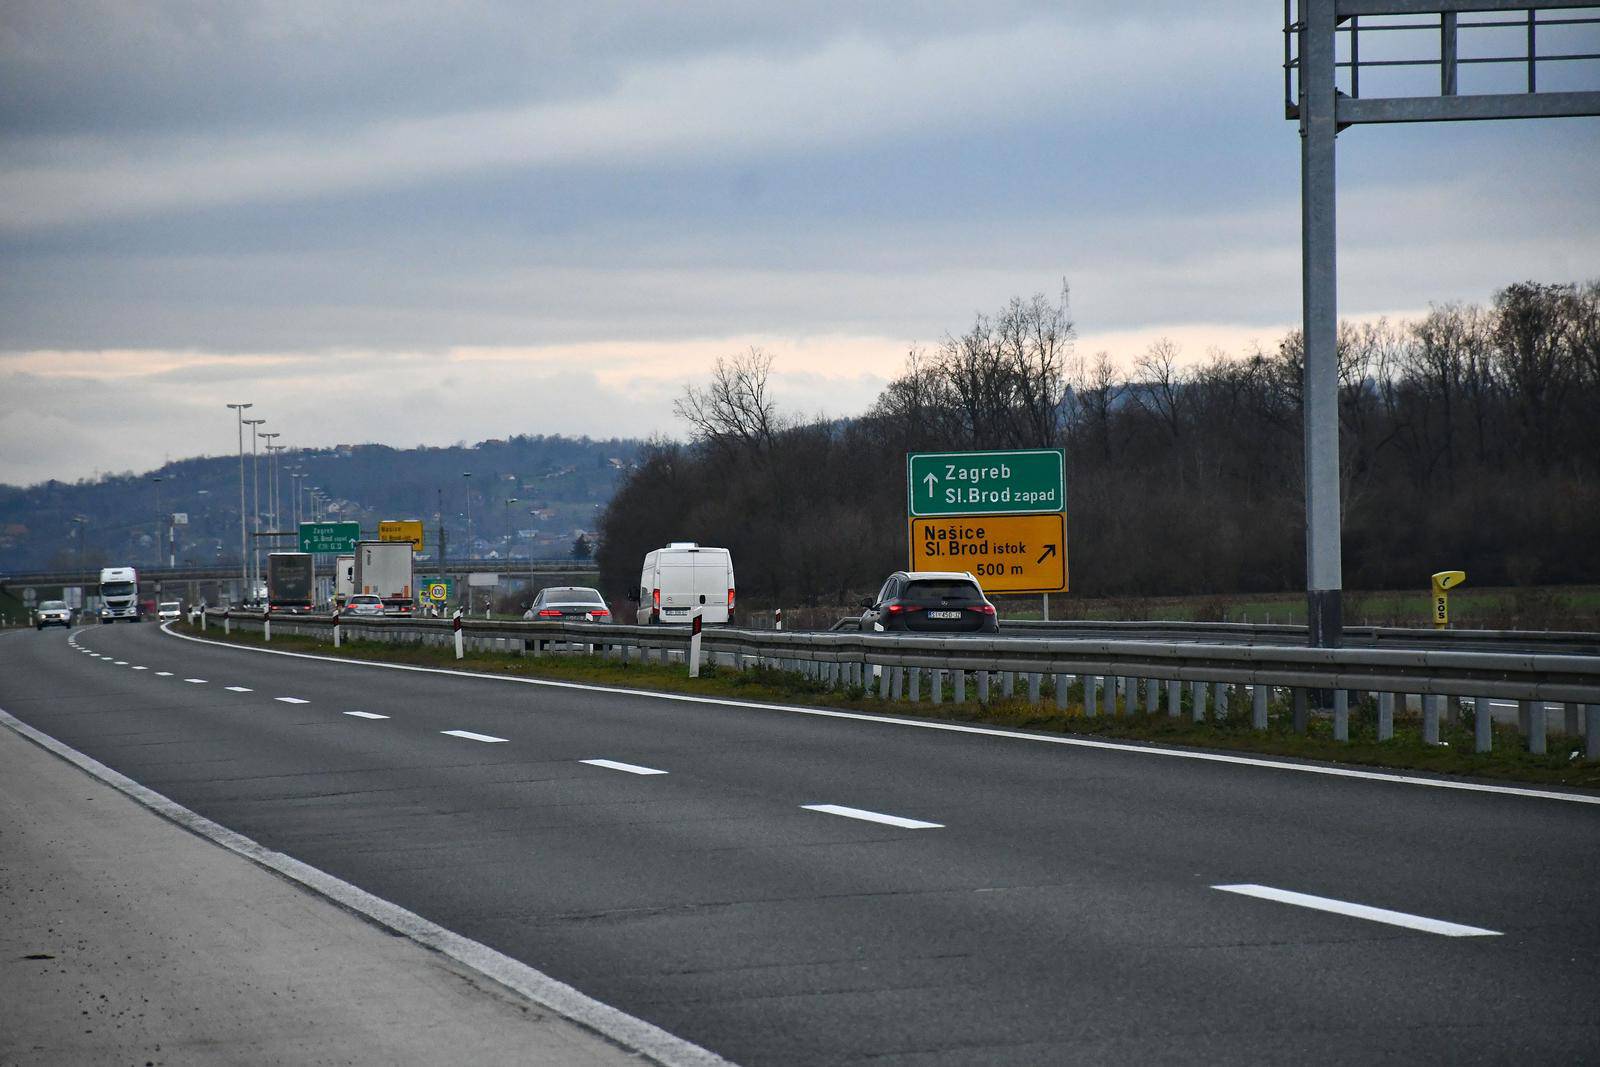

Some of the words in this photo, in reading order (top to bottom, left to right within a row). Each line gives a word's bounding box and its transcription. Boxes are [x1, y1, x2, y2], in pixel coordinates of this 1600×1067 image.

[945, 464, 1011, 484] Zagreb
[1014, 489, 1055, 504] zapad
[924, 524, 985, 540] Našice
[948, 540, 988, 556] Brod
[993, 542, 1026, 554] istok
[976, 564, 1005, 576] 500
[1011, 566, 1023, 575] m
[1437, 597, 1446, 619] SOS
